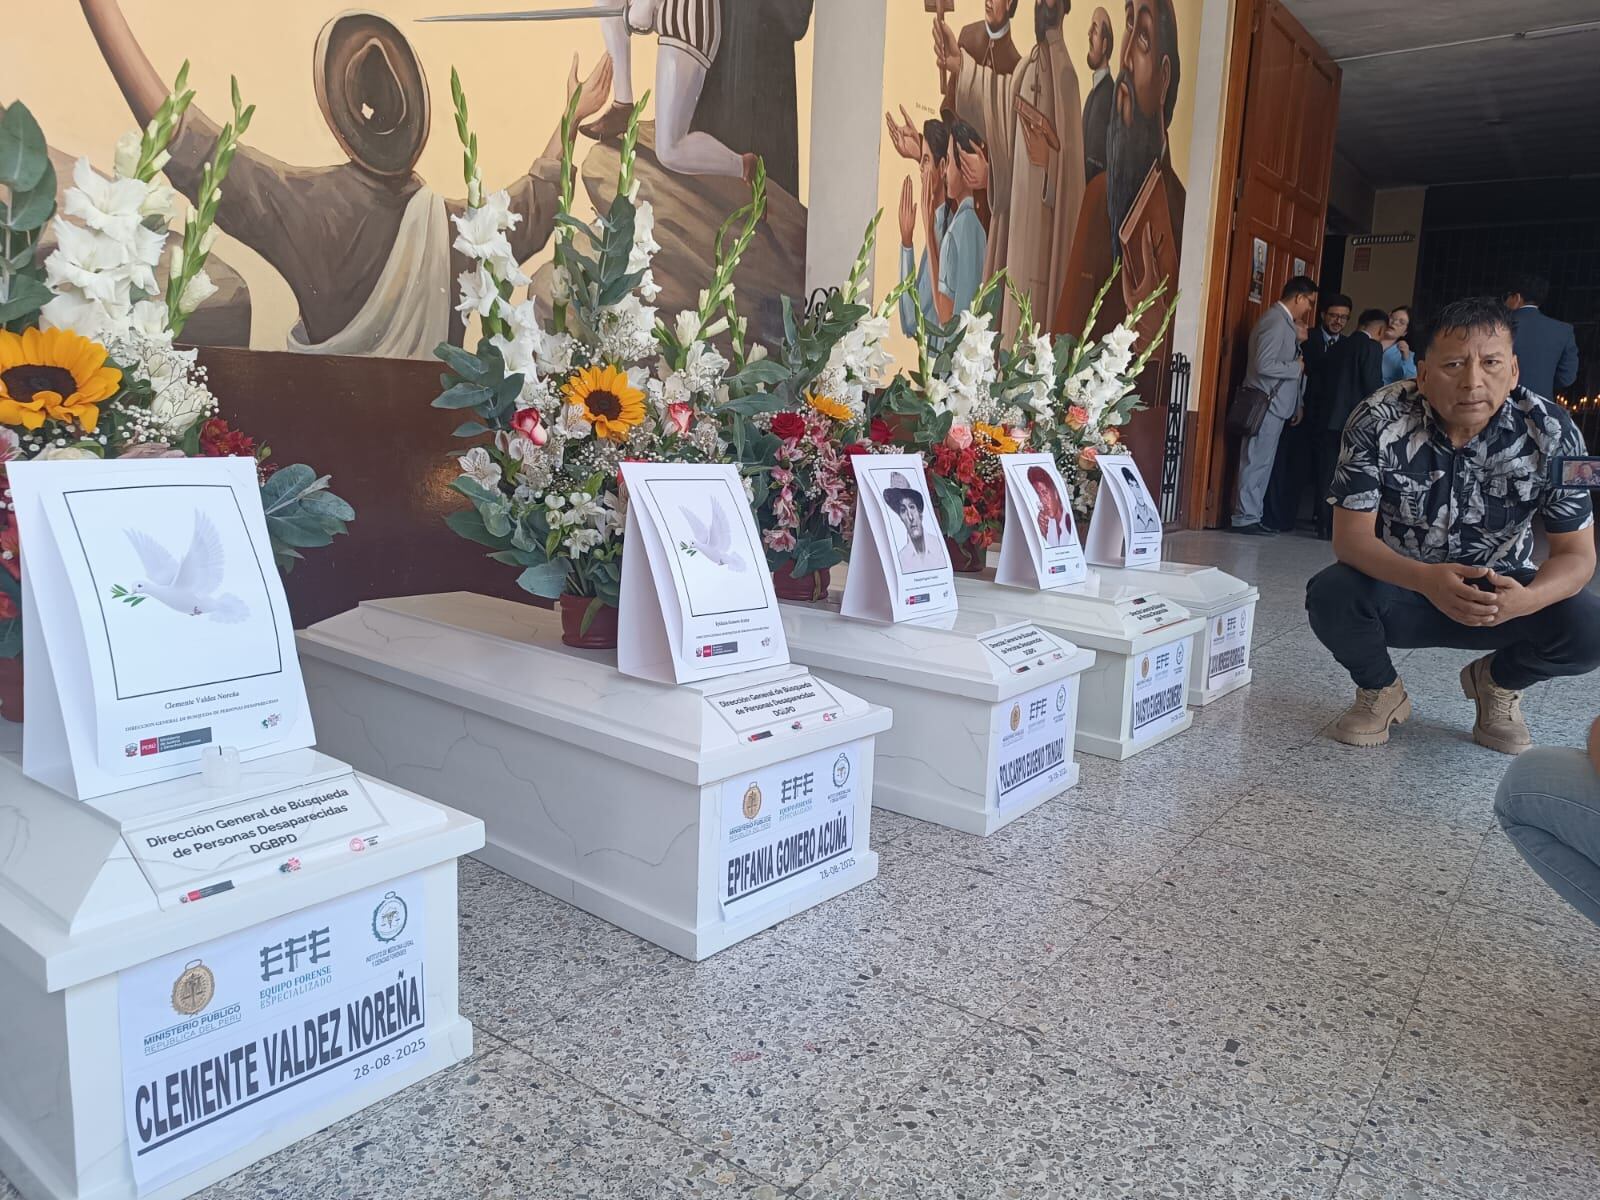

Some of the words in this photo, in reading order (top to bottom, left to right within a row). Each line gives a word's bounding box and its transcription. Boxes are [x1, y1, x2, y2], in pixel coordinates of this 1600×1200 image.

[780, 771, 814, 804] EFE
[146, 821, 215, 848] Dirección
[216, 808, 270, 832] General
[270, 804, 287, 818] de
[287, 787, 349, 812] Búsqueda
[172, 845, 192, 860] de
[193, 828, 257, 855] Personas
[257, 803, 349, 836] Desaparecidas
[249, 833, 298, 855] DGBPD
[727, 844, 774, 897] EPIFANIA
[776, 827, 815, 877] GOMERO
[817, 809, 847, 859] ACUÑA
[819, 857, 856, 880] 28-08-2025
[259, 926, 331, 982] EFE
[260, 979, 293, 999] EQUIPO
[294, 965, 332, 990] FORENSE
[260, 975, 332, 1010] ESPECIALIZADO
[143, 1019, 199, 1046] MINISTERIO
[200, 1004, 241, 1026] PÚBLICO
[135, 1040, 259, 1144] CLEMENTE
[263, 1007, 342, 1088] VALDEZ
[347, 968, 421, 1053] NOREÑA
[353, 1038, 426, 1081] 28-08-2025
